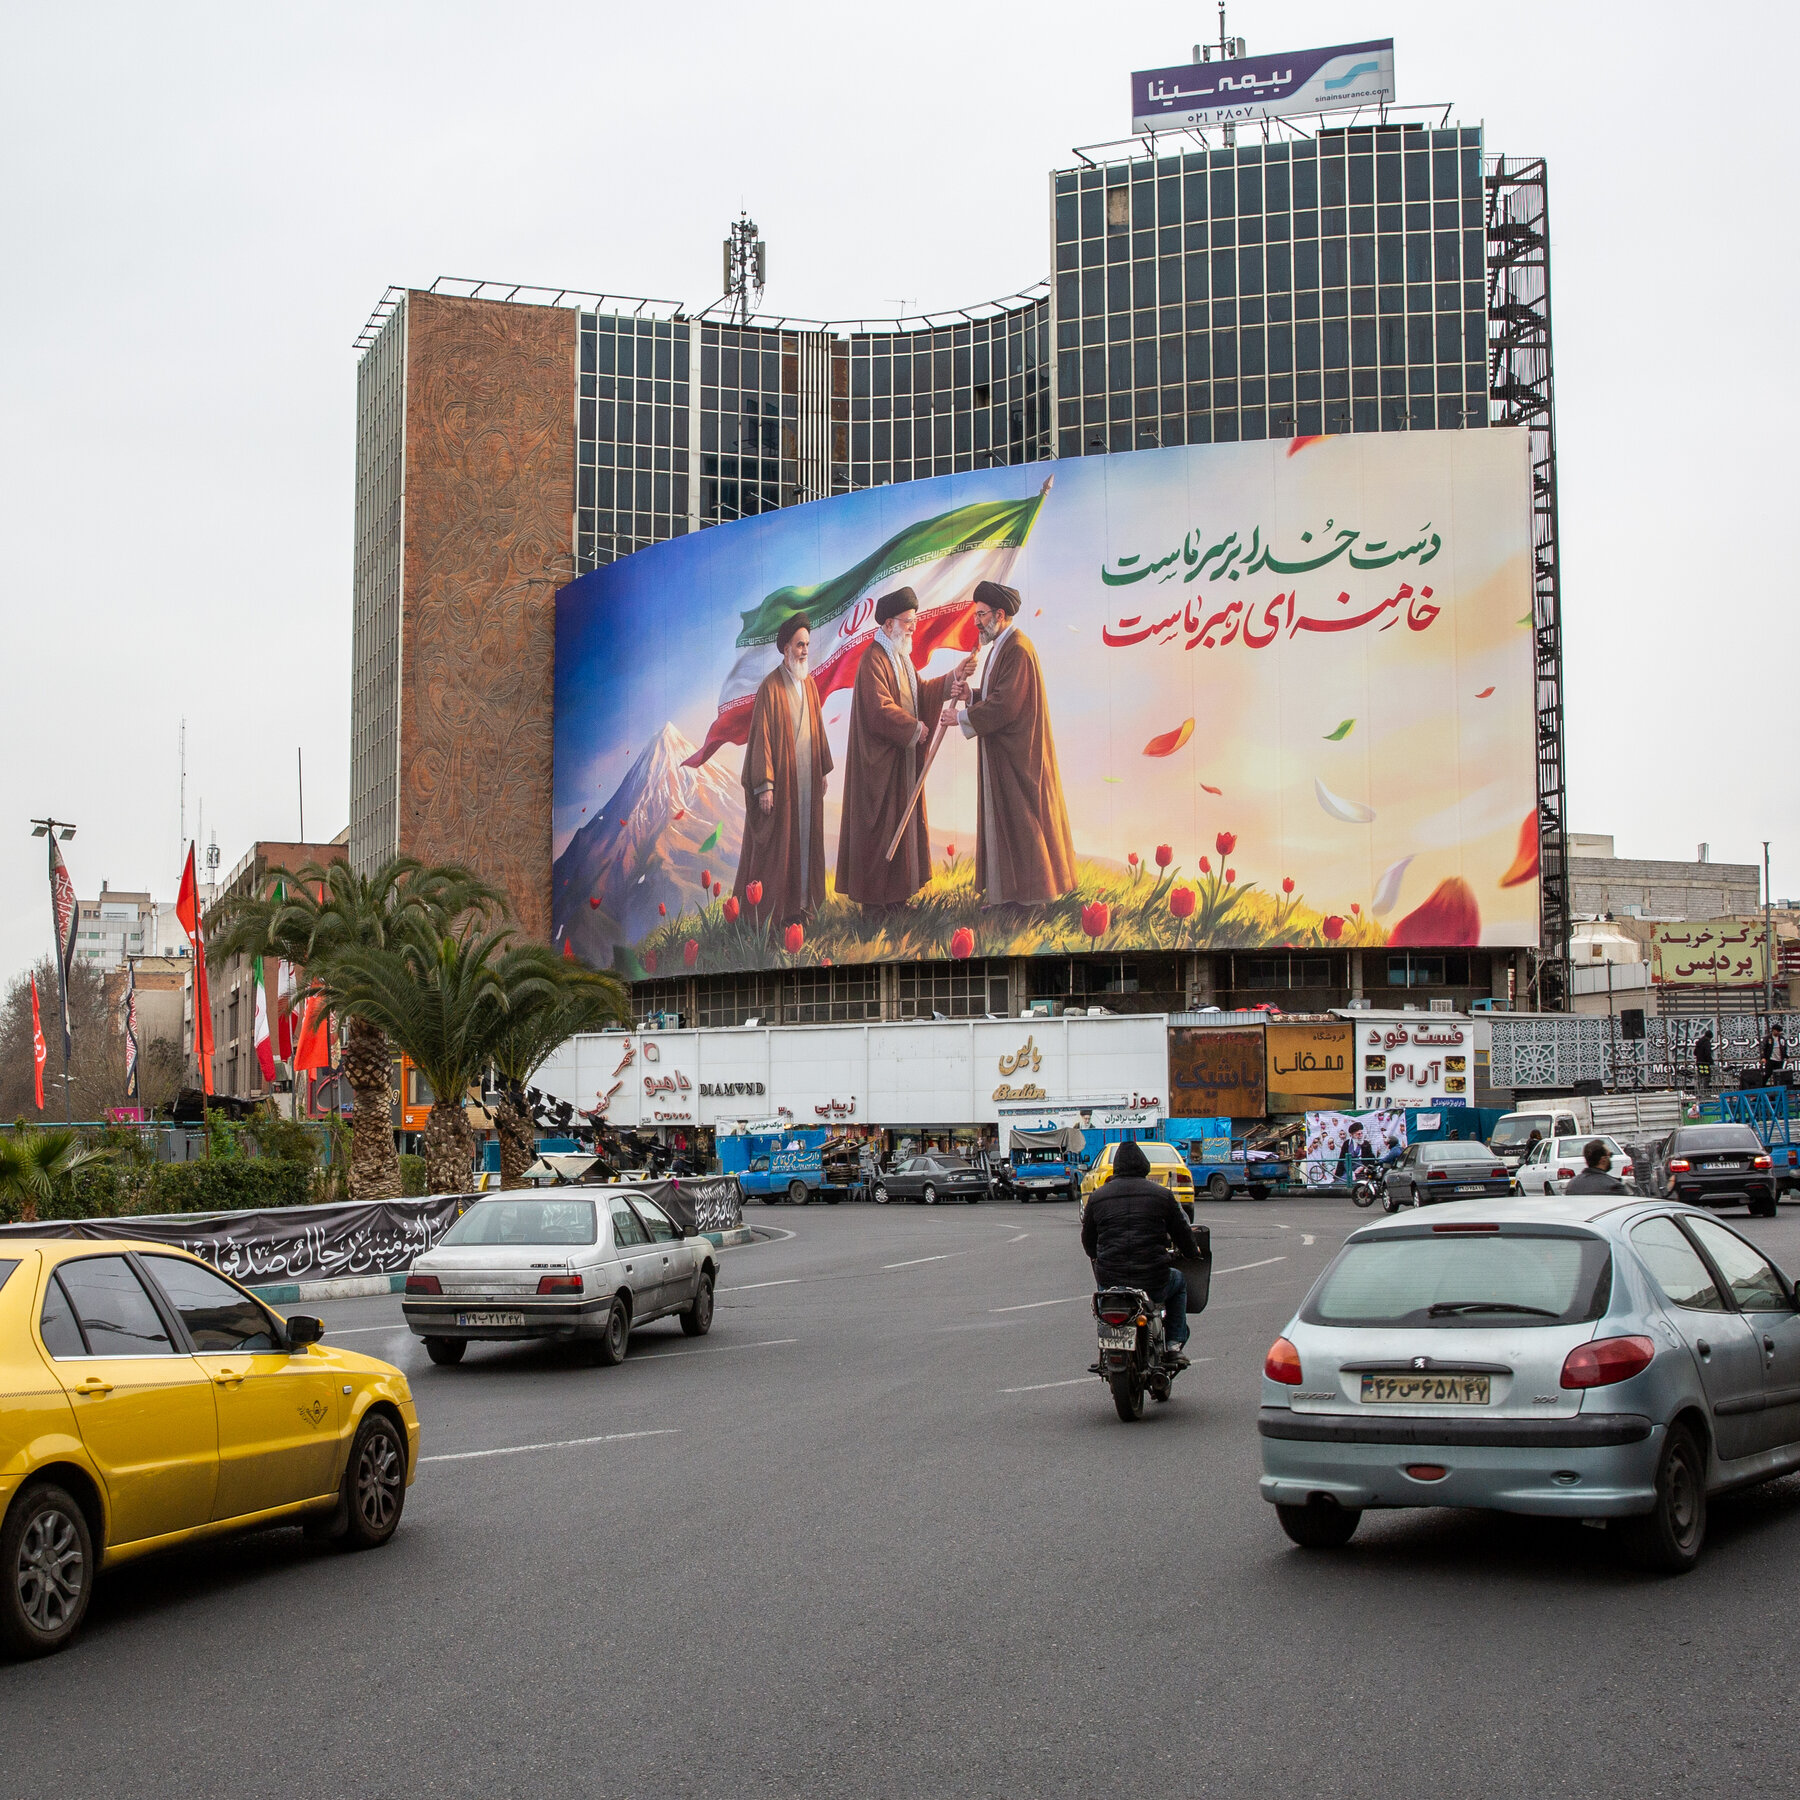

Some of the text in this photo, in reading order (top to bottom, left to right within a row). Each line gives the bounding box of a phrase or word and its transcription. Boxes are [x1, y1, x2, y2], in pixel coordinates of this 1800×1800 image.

[1148, 69, 1292, 106] بیمه سینا
[1315, 88, 1389, 102] sinainsurance.com
[1188, 107, 1253, 124] ۰۲۱ ۲۸۰۷
[1185, 598, 1244, 651] رهبر
[1660, 928, 1767, 948] مرکز خرید
[1675, 953, 1753, 977] پردیس
[1312, 1032, 1346, 1042] فروشگاه
[1368, 1023, 1464, 1050] فست فود
[612, 1037, 636, 1077] شهر
[998, 1035, 1042, 1076] بالین
[1389, 1061, 1442, 1087] آرام
[643, 1069, 692, 1101] بامبو
[992, 1083, 1046, 1101] Balin
[814, 1096, 856, 1118] زیبایی
[1129, 1092, 1160, 1109] موز
[1365, 1097, 1392, 1108] VIP
[1104, 1113, 1147, 1124] موکب برادران
[1293, 1391, 1336, 1401] PEUGEOT
[1532, 1394, 1559, 1404] 206
